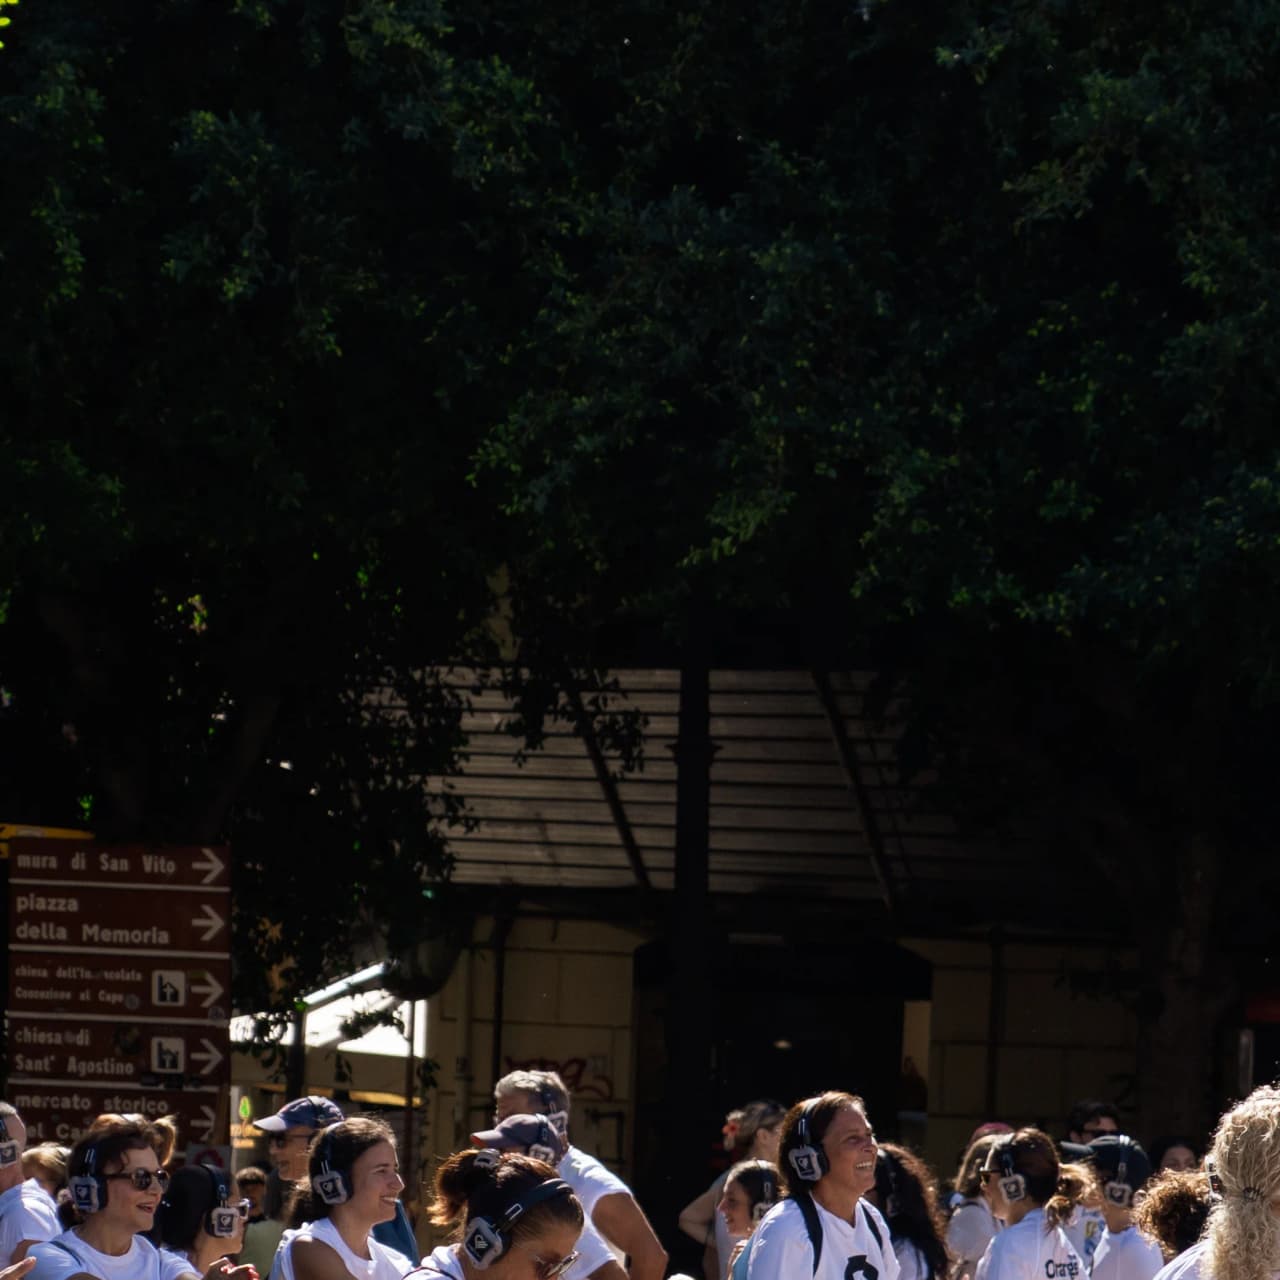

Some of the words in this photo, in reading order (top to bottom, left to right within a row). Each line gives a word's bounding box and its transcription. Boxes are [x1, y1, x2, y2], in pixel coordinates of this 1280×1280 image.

[17, 854, 57, 869] mura
[71, 852, 87, 870] di
[99, 853, 130, 872] San
[142, 855, 176, 874] Vito
[16, 893, 79, 912] piazza
[16, 922, 68, 940] della
[82, 924, 170, 944] Memoria
[15, 965, 48, 978] chiesa
[15, 987, 72, 1000] Concezione
[80, 991, 90, 1001] al
[15, 1026, 63, 1045] chiesa
[76, 1029, 90, 1046] di
[15, 1054, 56, 1072] Sant'
[67, 1056, 134, 1076] Agostino
[15, 1094, 92, 1111] mercato
[104, 1096, 168, 1114] storico
[27, 1123, 44, 1138] el
[55, 1124, 92, 1140] Ca
